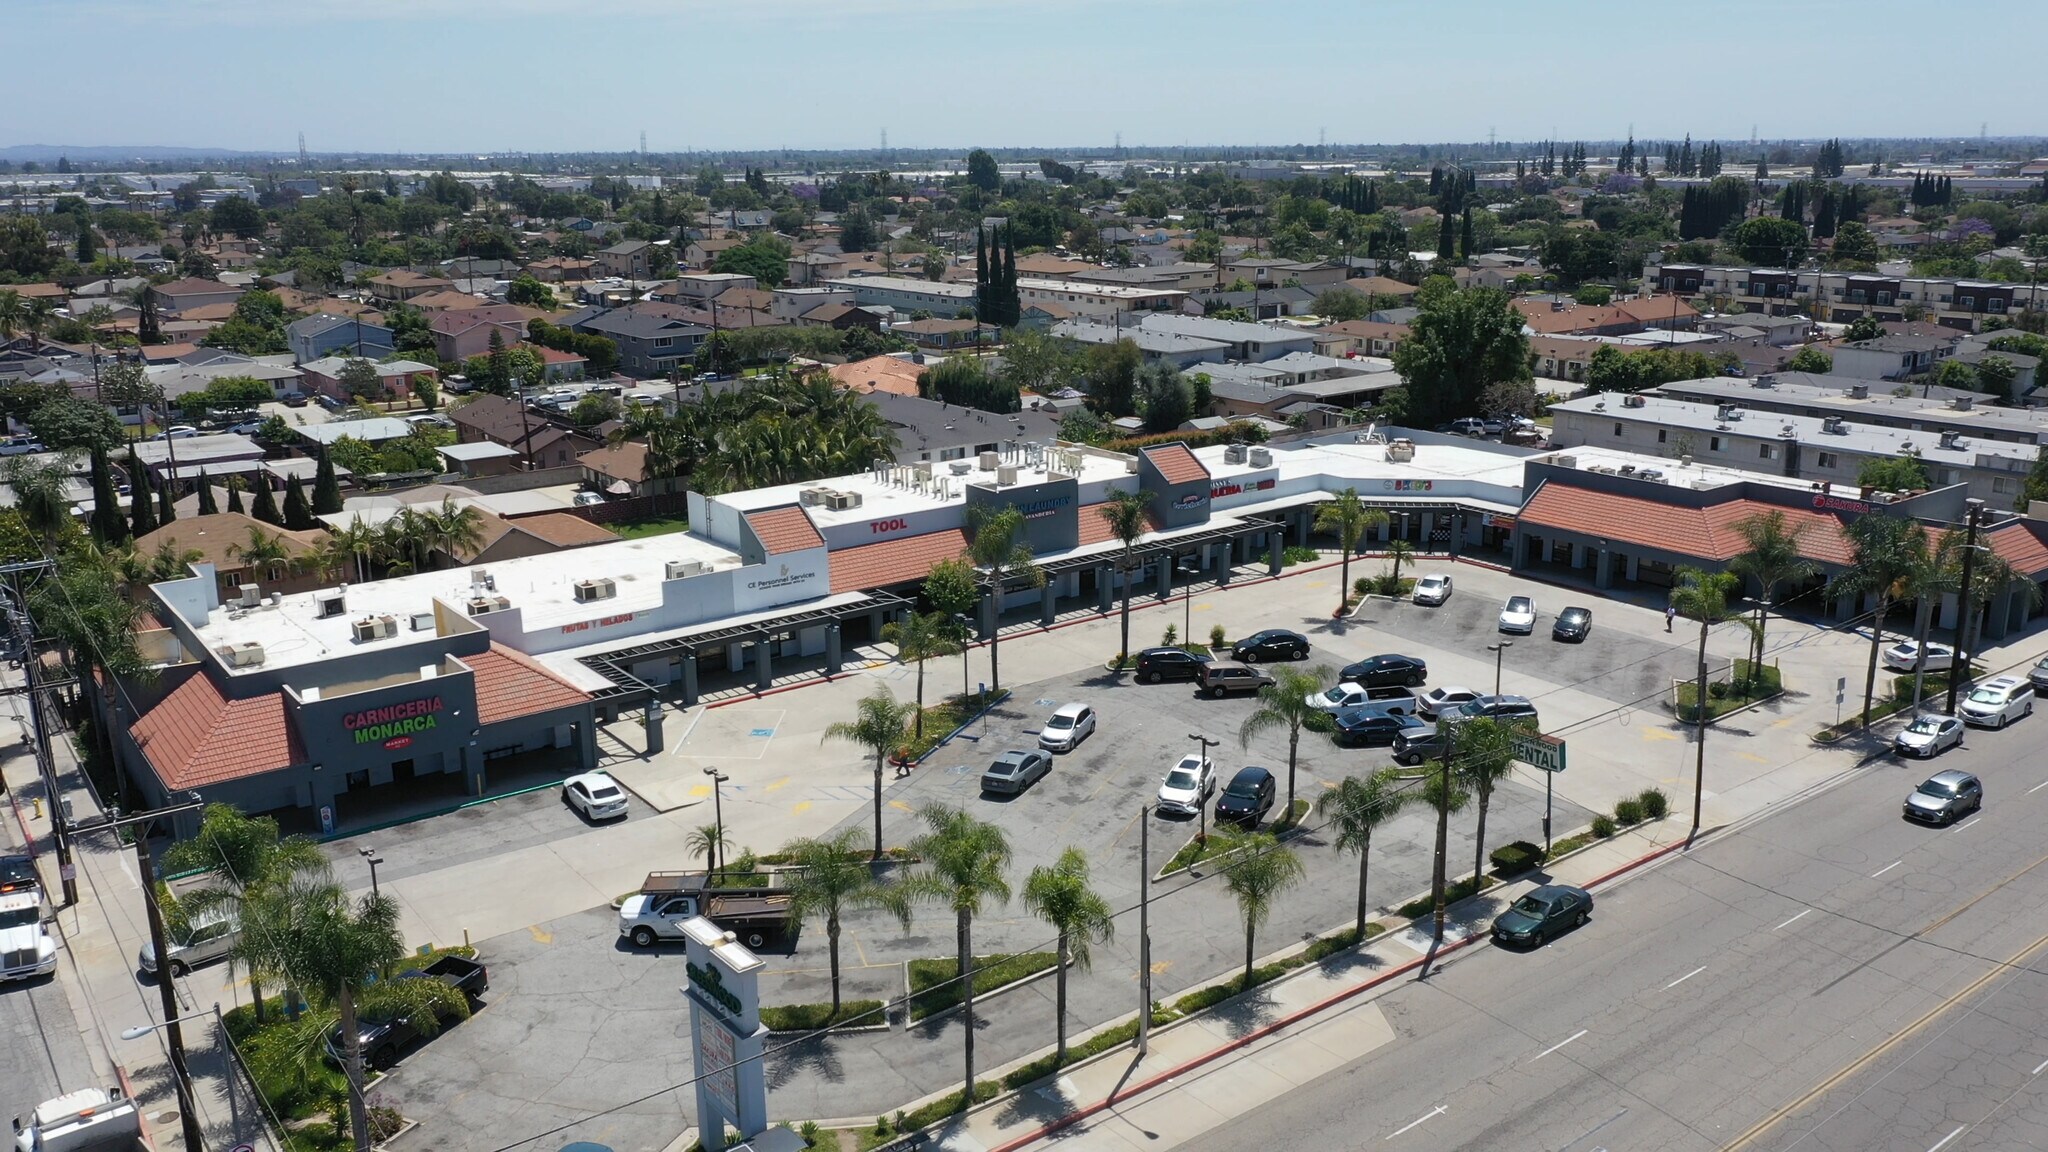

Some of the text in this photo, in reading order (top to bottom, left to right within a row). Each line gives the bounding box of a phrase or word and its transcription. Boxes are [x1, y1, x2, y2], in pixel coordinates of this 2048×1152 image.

[1825, 498, 1869, 513] SAKURA
[1025, 510, 1056, 519] AVANDERIA
[870, 518, 907, 534] TOOL
[747, 581, 756, 589] CE
[758, 576, 789, 587] Personnel
[790, 572, 815, 581] Services
[561, 621, 589, 634] FRUTAS
[592, 620, 597, 628] Y
[601, 613, 633, 627] HELADOS
[343, 697, 444, 729] CARNICERIA
[355, 714, 437, 744] MONARCA
